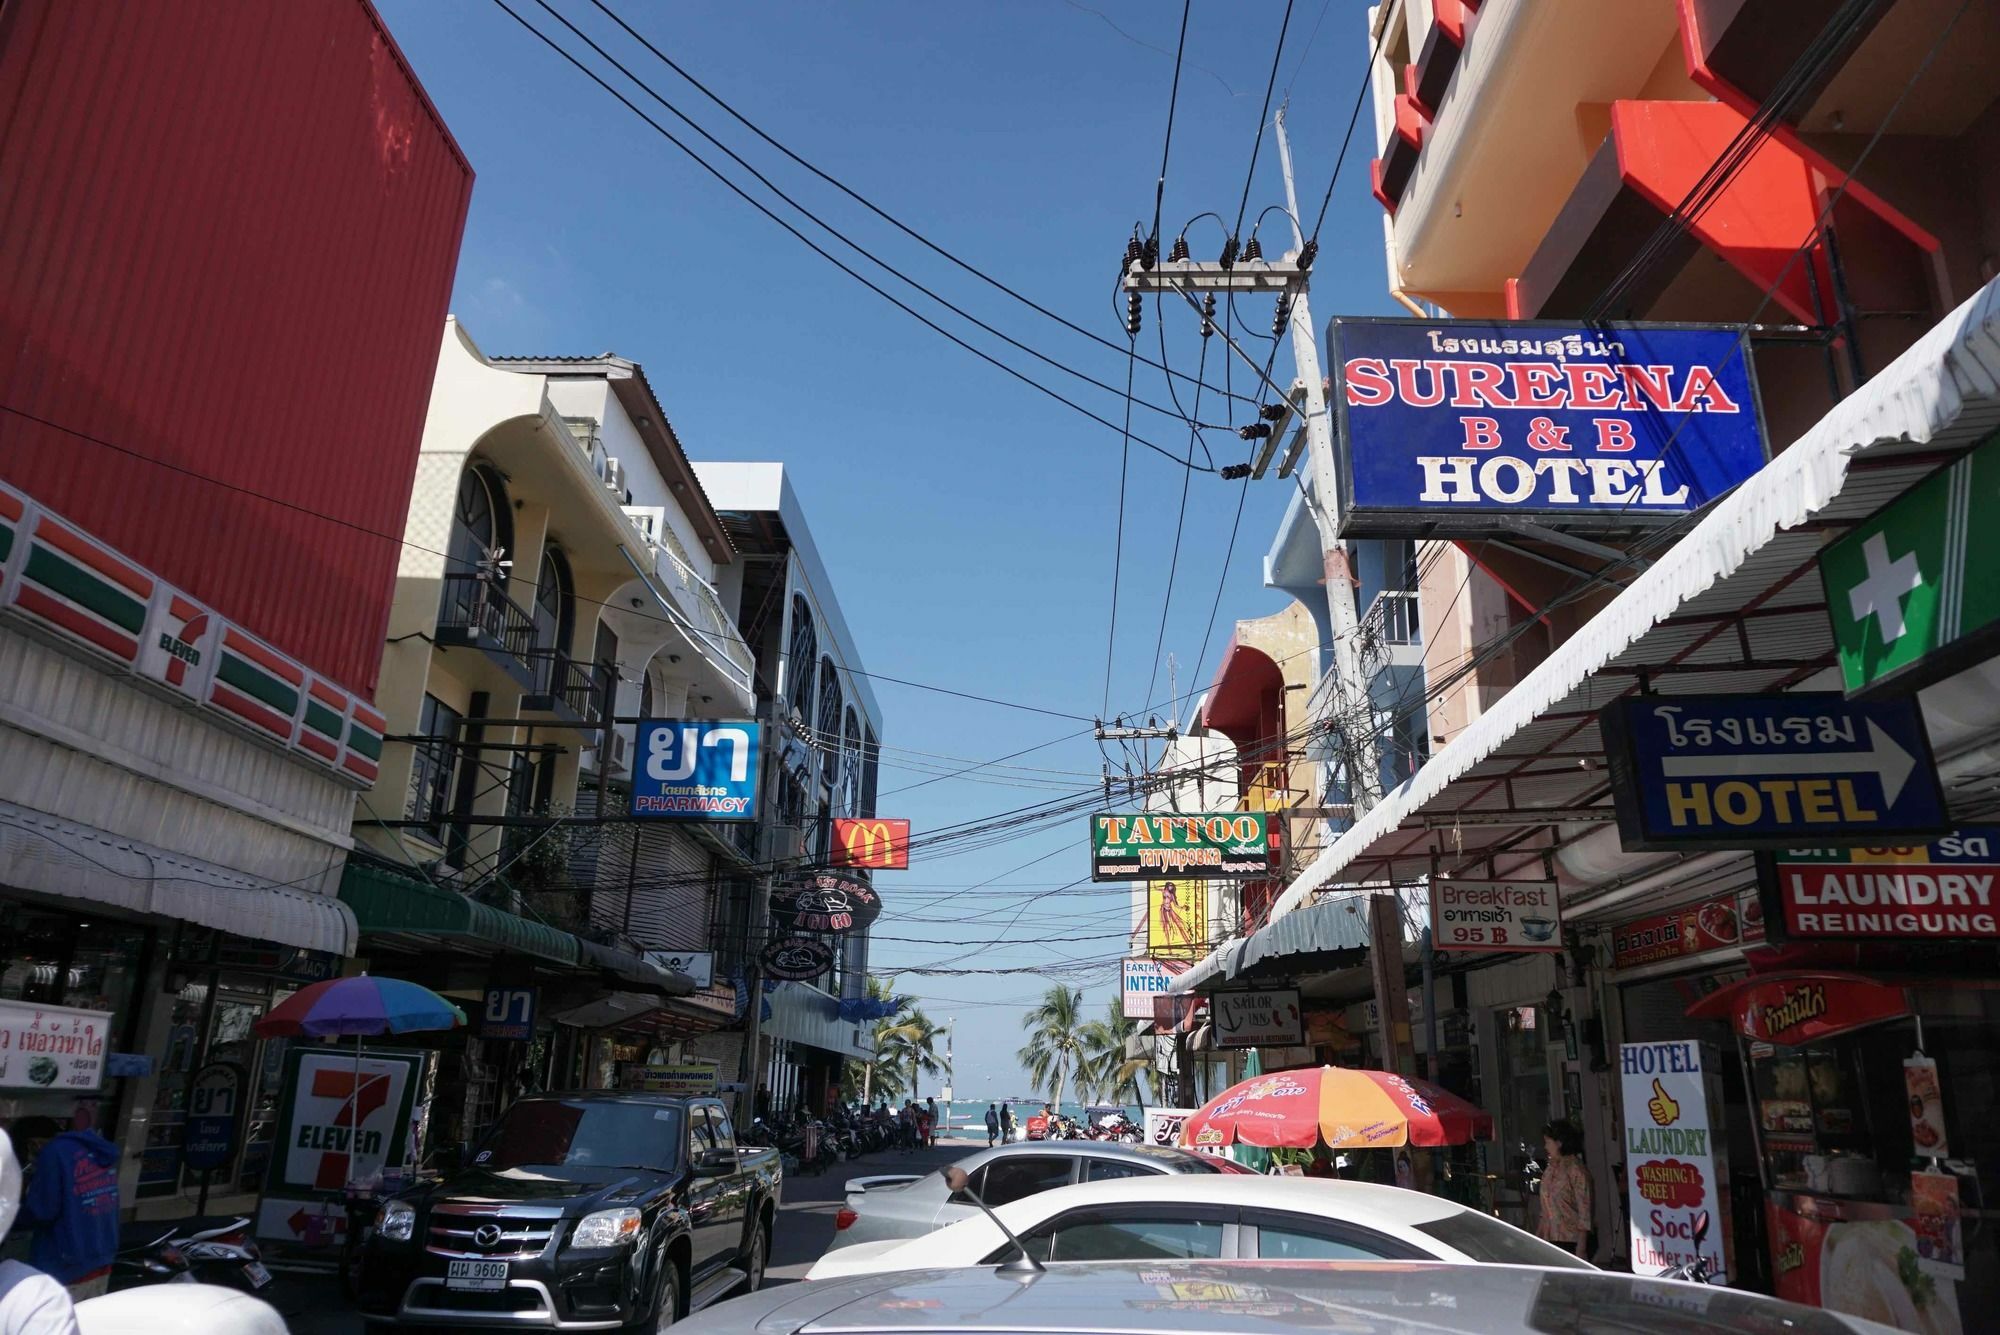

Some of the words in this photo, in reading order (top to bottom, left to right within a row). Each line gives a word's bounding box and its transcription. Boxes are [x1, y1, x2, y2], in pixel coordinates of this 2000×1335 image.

[1427, 331, 1625, 363] โรงแรมสุรีน่า
[1345, 357, 1740, 413] SUREENA
[1460, 416, 1502, 450] B
[1527, 416, 1573, 452] &
[1593, 418, 1636, 452] B
[1417, 456, 1690, 504] HOTEL
[1654, 705, 1857, 748] โรงแรม
[647, 727, 750, 782] ยา
[636, 796, 750, 813] PHARMACY
[1666, 779, 1878, 826] HOTEL
[1099, 816, 1260, 844] TATTOO
[1138, 847, 1222, 873] татуировка
[1442, 886, 1549, 906] Breakfast
[1791, 873, 1995, 905] LAUNDRY
[1444, 906, 1513, 922] อาหารเช้า
[1797, 913, 1997, 932] REINIGUNG
[1453, 927, 1484, 942] 95
[1126, 963, 1155, 972] EARTH
[486, 990, 531, 1022] ยา
[1233, 995, 1273, 1009] SAILOR
[1622, 1044, 1698, 1074] HOTEL
[194, 1088, 235, 1114] ยา
[1628, 1127, 1708, 1157] LAUNDRY
[1641, 1166, 1688, 1184] WASHING
[1642, 1184, 1667, 1200] FREE
[1637, 1240, 1681, 1267] Under
[474, 1263, 507, 1278] 9609
